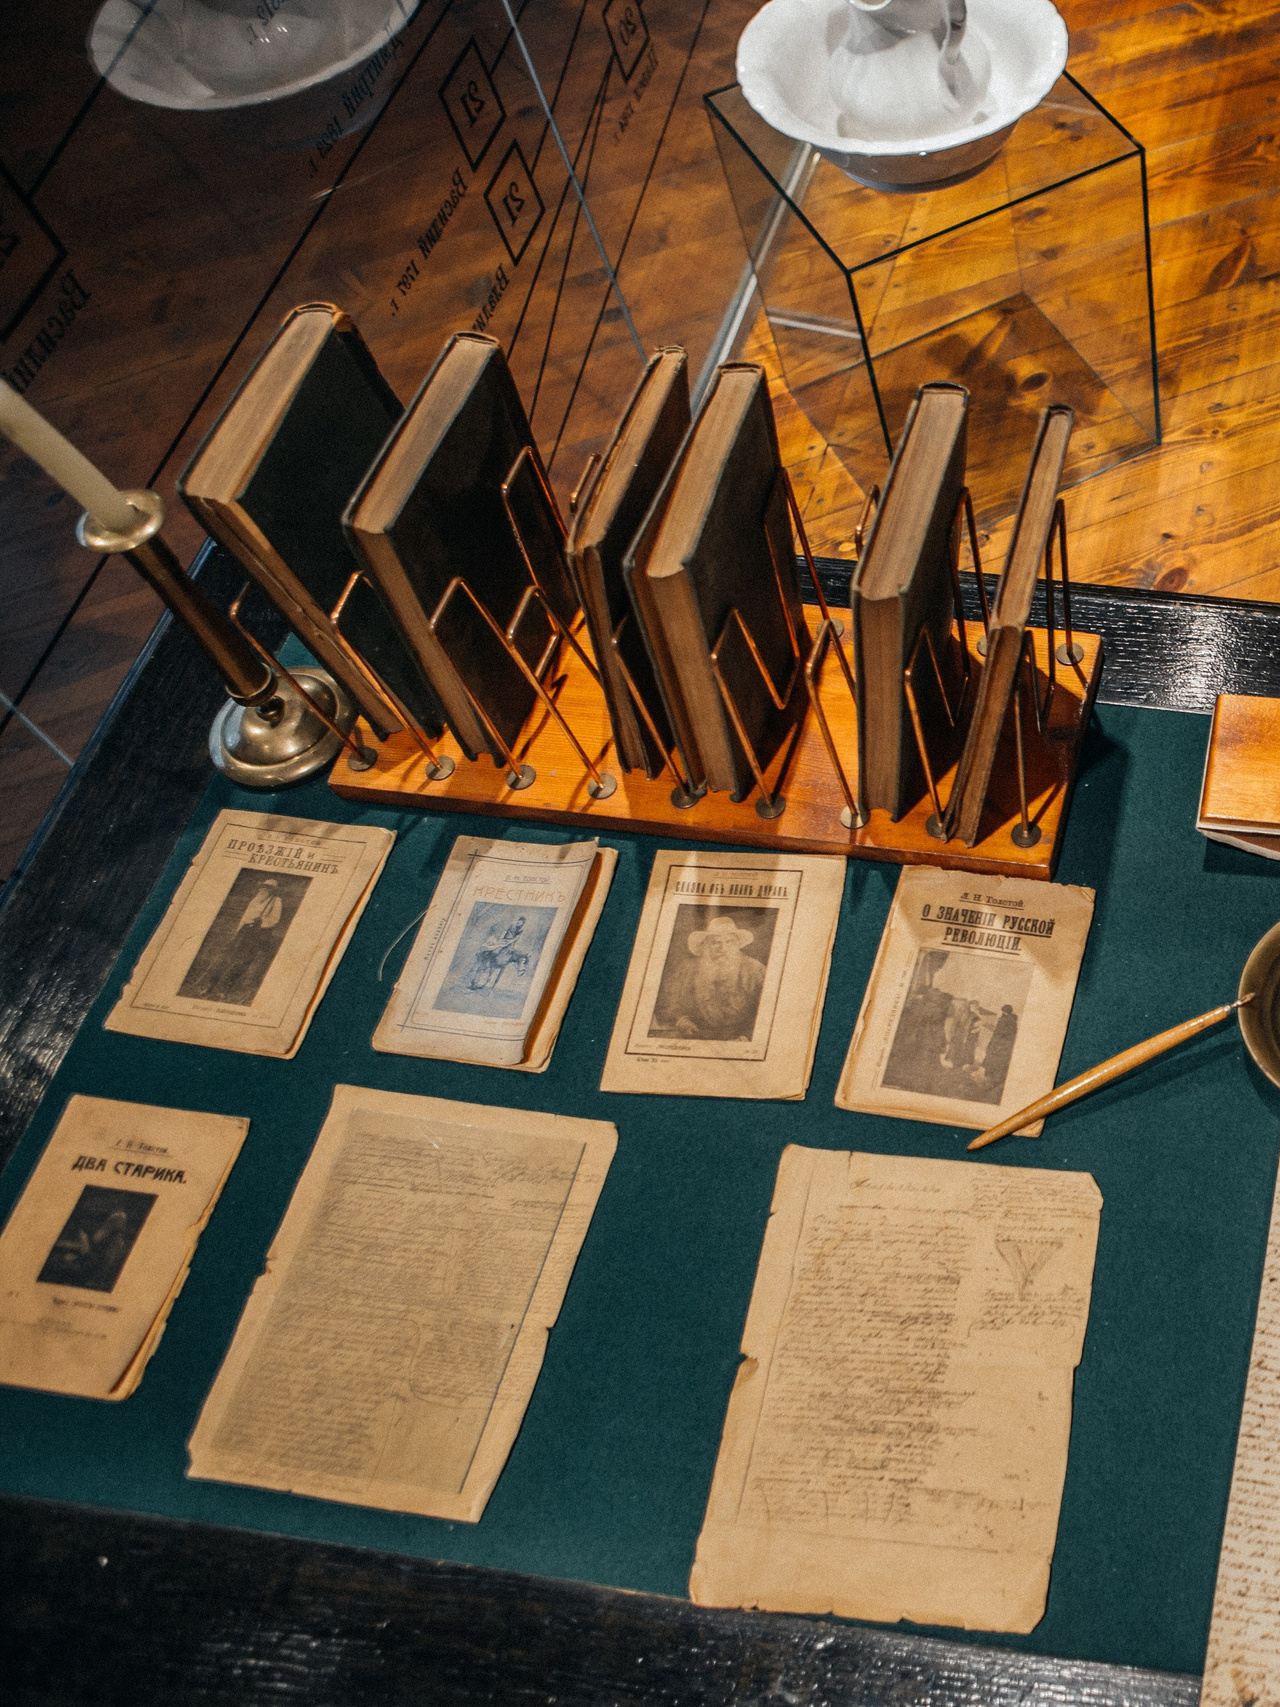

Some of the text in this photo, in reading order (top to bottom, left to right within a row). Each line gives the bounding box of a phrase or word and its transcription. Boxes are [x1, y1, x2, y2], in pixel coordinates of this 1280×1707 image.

[473, 886, 566, 903] КРЕСТНИКЪ
[922, 904, 931, 918] О
[1002, 915, 1055, 935] РУССКОЙ
[71, 1155, 187, 1184] ДВА СТАРИКА.
